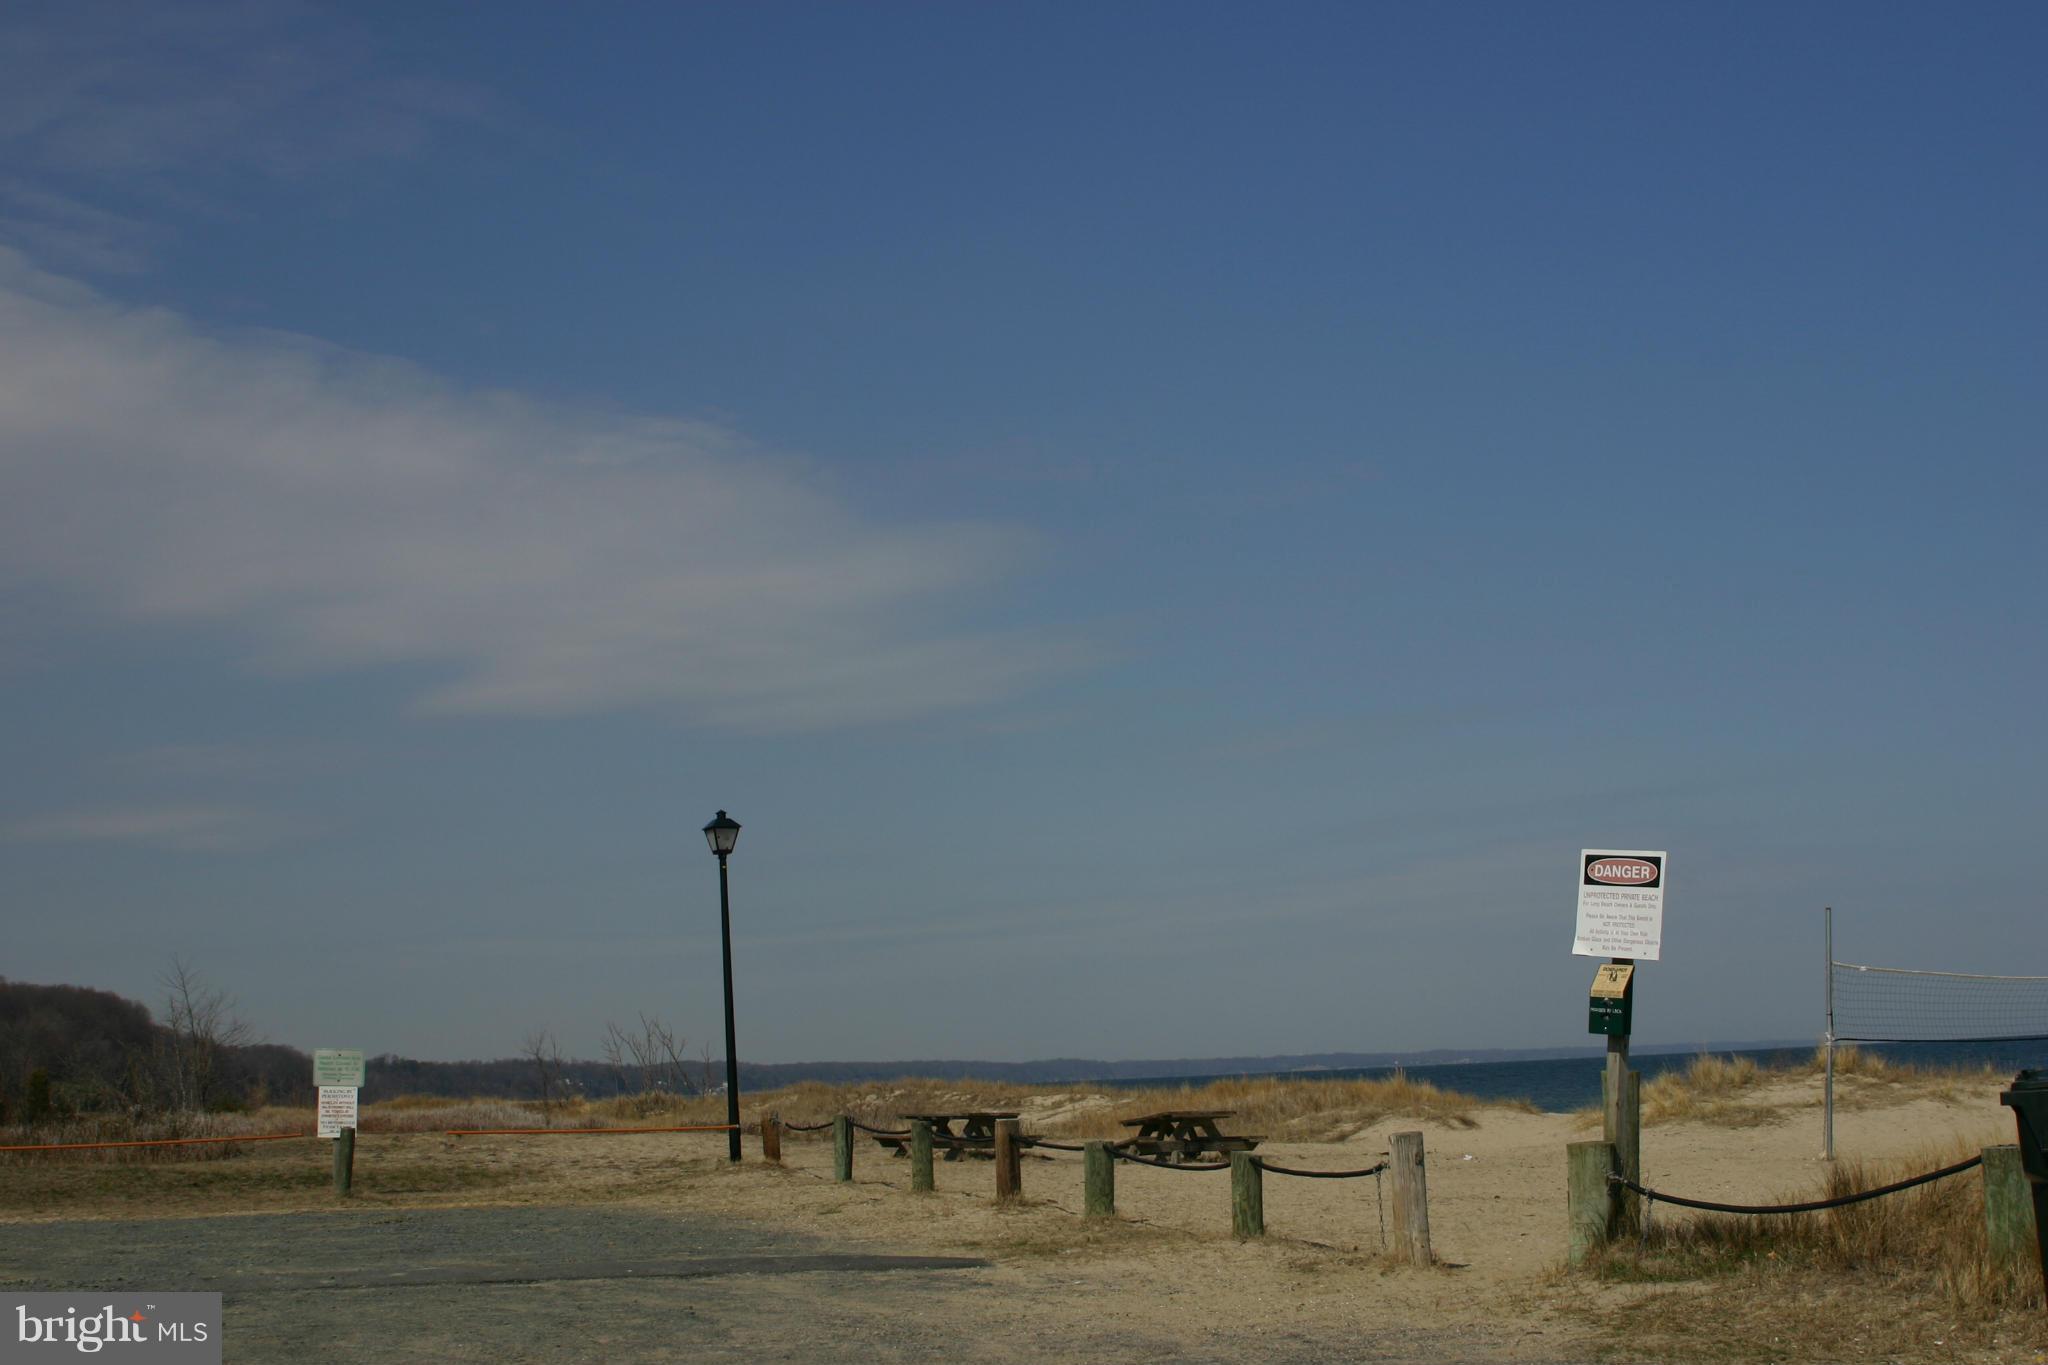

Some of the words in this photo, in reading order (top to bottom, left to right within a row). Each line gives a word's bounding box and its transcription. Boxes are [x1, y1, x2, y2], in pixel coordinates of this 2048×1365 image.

[1594, 865, 1650, 879] DANGER
[1583, 891, 1620, 900] UNPROTECTED
[1621, 893, 1640, 901] PRIVATE
[1641, 894, 1659, 902] BEACH
